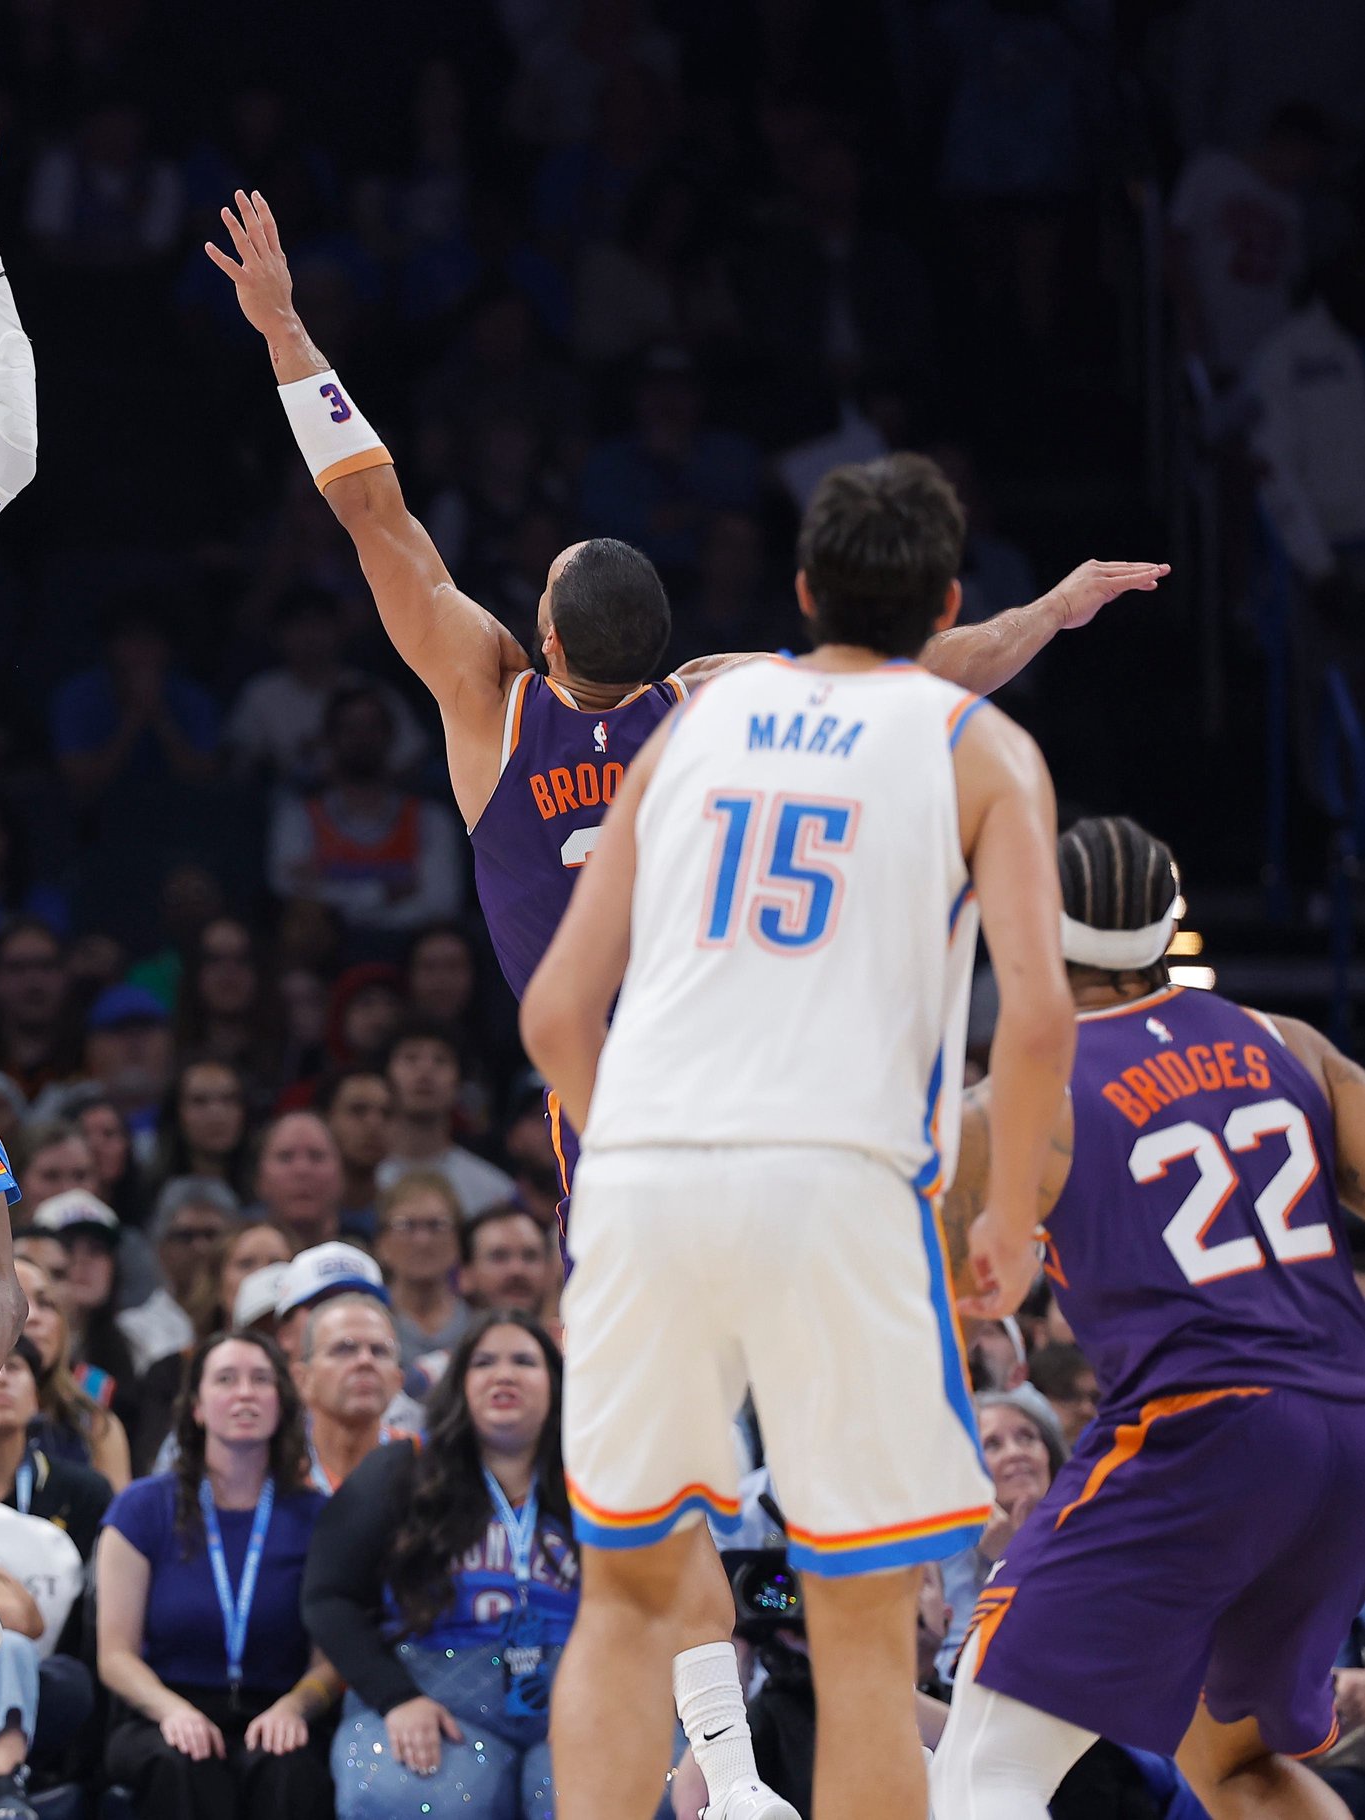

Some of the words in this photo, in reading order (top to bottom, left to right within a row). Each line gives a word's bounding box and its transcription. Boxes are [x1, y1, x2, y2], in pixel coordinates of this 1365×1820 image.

[319, 383, 352, 424] 3
[748, 712, 865, 758] MARA
[529, 761, 626, 820] BROO
[696, 788, 863, 958] 15
[1101, 1041, 1272, 1128] BRIDGES
[1127, 1097, 1337, 1287] 22
